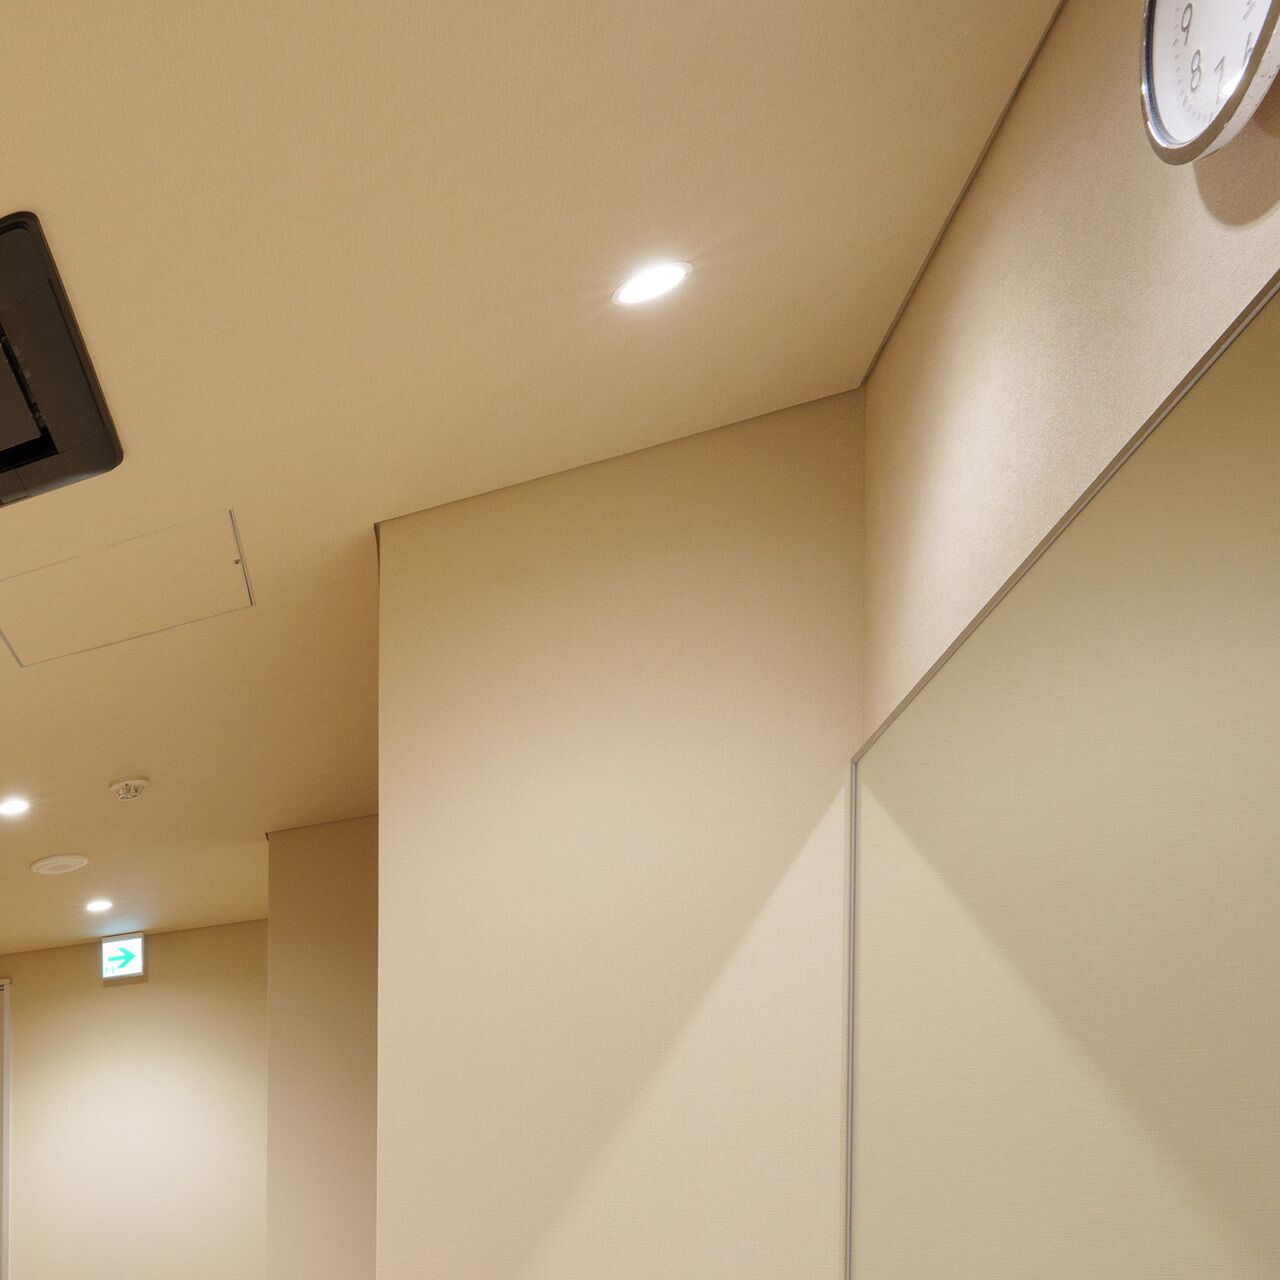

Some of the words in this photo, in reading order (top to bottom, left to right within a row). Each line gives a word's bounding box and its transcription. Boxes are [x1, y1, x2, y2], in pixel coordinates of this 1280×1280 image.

[1181, 2, 1193, 46] 9
[1190, 49, 1202, 92] 8
[1214, 55, 1226, 105] 7
